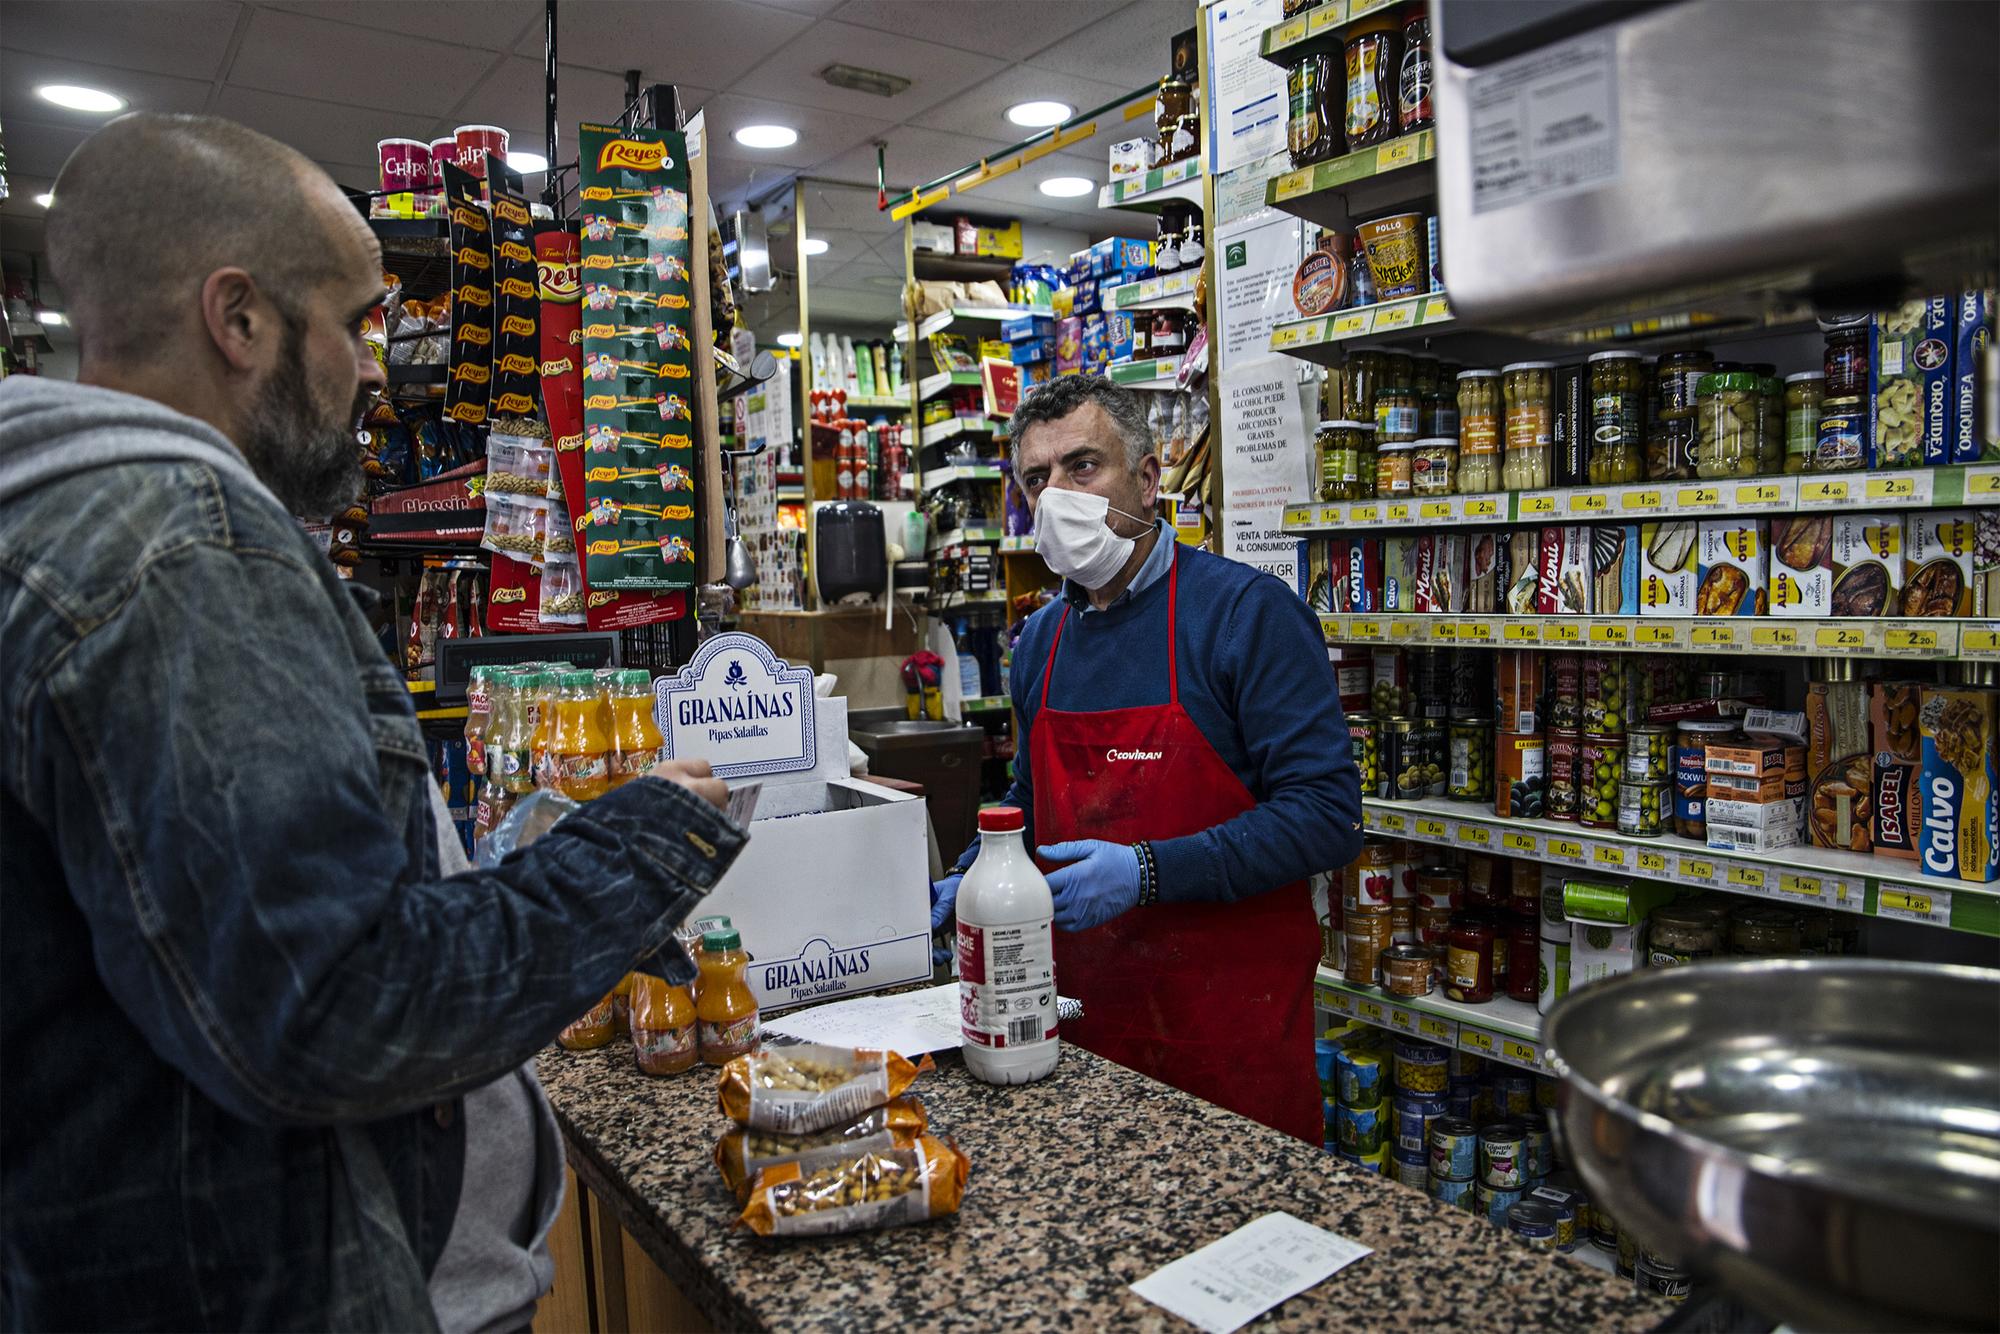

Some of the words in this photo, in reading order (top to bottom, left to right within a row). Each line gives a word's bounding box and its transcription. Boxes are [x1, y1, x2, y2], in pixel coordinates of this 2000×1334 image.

[606, 144, 661, 164] Reyes
[498, 203, 526, 220] Reyes
[1375, 221, 1401, 233] POLLO
[502, 244, 529, 260] Reyes
[1375, 258, 1416, 283] YATEKOMO
[504, 281, 533, 297] Reyes
[539, 265, 581, 296] Rey
[461, 287, 489, 304] Reyes
[504, 316, 533, 333] Reyes
[461, 326, 489, 341] Reyes
[458, 365, 488, 380] Reyes
[503, 356, 532, 373] Reyes
[1233, 388, 1240, 398] EL
[1242, 384, 1273, 396] CONSUMO
[1275, 381, 1284, 390] DE
[500, 395, 530, 411] Reyes
[1232, 397, 1263, 409] ALCOHOL
[1264, 392, 1286, 403] PUEDE
[454, 404, 483, 420] Reyes
[1242, 407, 1276, 419] PRODUCIR
[1930, 381, 1944, 458] ORQUIDEA
[1959, 373, 1974, 451] ORQUIDEA
[1237, 419, 1276, 431] ADICCIONES
[1247, 431, 1274, 441] GRAVES
[1236, 442, 1276, 454] PROBLEMAS
[1278, 440, 1287, 449] DE
[1251, 453, 1274, 464] SALUD
[1267, 486, 1286, 495] VENTA
[1232, 501, 1257, 510] MENORES
[1236, 531, 1260, 540] VENTA
[1880, 522, 1889, 559] ALBO
[1953, 518, 1964, 557] ALBO
[1236, 543, 1245, 552] AL
[1247, 541, 1297, 552] CONSUMIDOR
[1738, 527, 1747, 562] ALBO
[1277, 564, 1293, 576] GR
[494, 588, 523, 603] Reyes
[1387, 579, 1396, 608] Calvo
[1648, 574, 1656, 608] ALBO
[1778, 572, 1787, 608] ALBO
[679, 690, 793, 725] GRANAÍNAS
[709, 729, 733, 743] Pipas
[734, 725, 768, 739] Salaíllas
[1882, 768, 1901, 843] ISABEL
[1911, 779, 1921, 837] MEJILLONES
[1925, 777, 1954, 872] Calvo
[1989, 790, 1999, 866] Calvo
[765, 950, 870, 990] GRANAÍNAS
[791, 986, 813, 1000] Pipas
[814, 980, 846, 994] Salaíllas
[1486, 1143, 1512, 1152] Gigante
